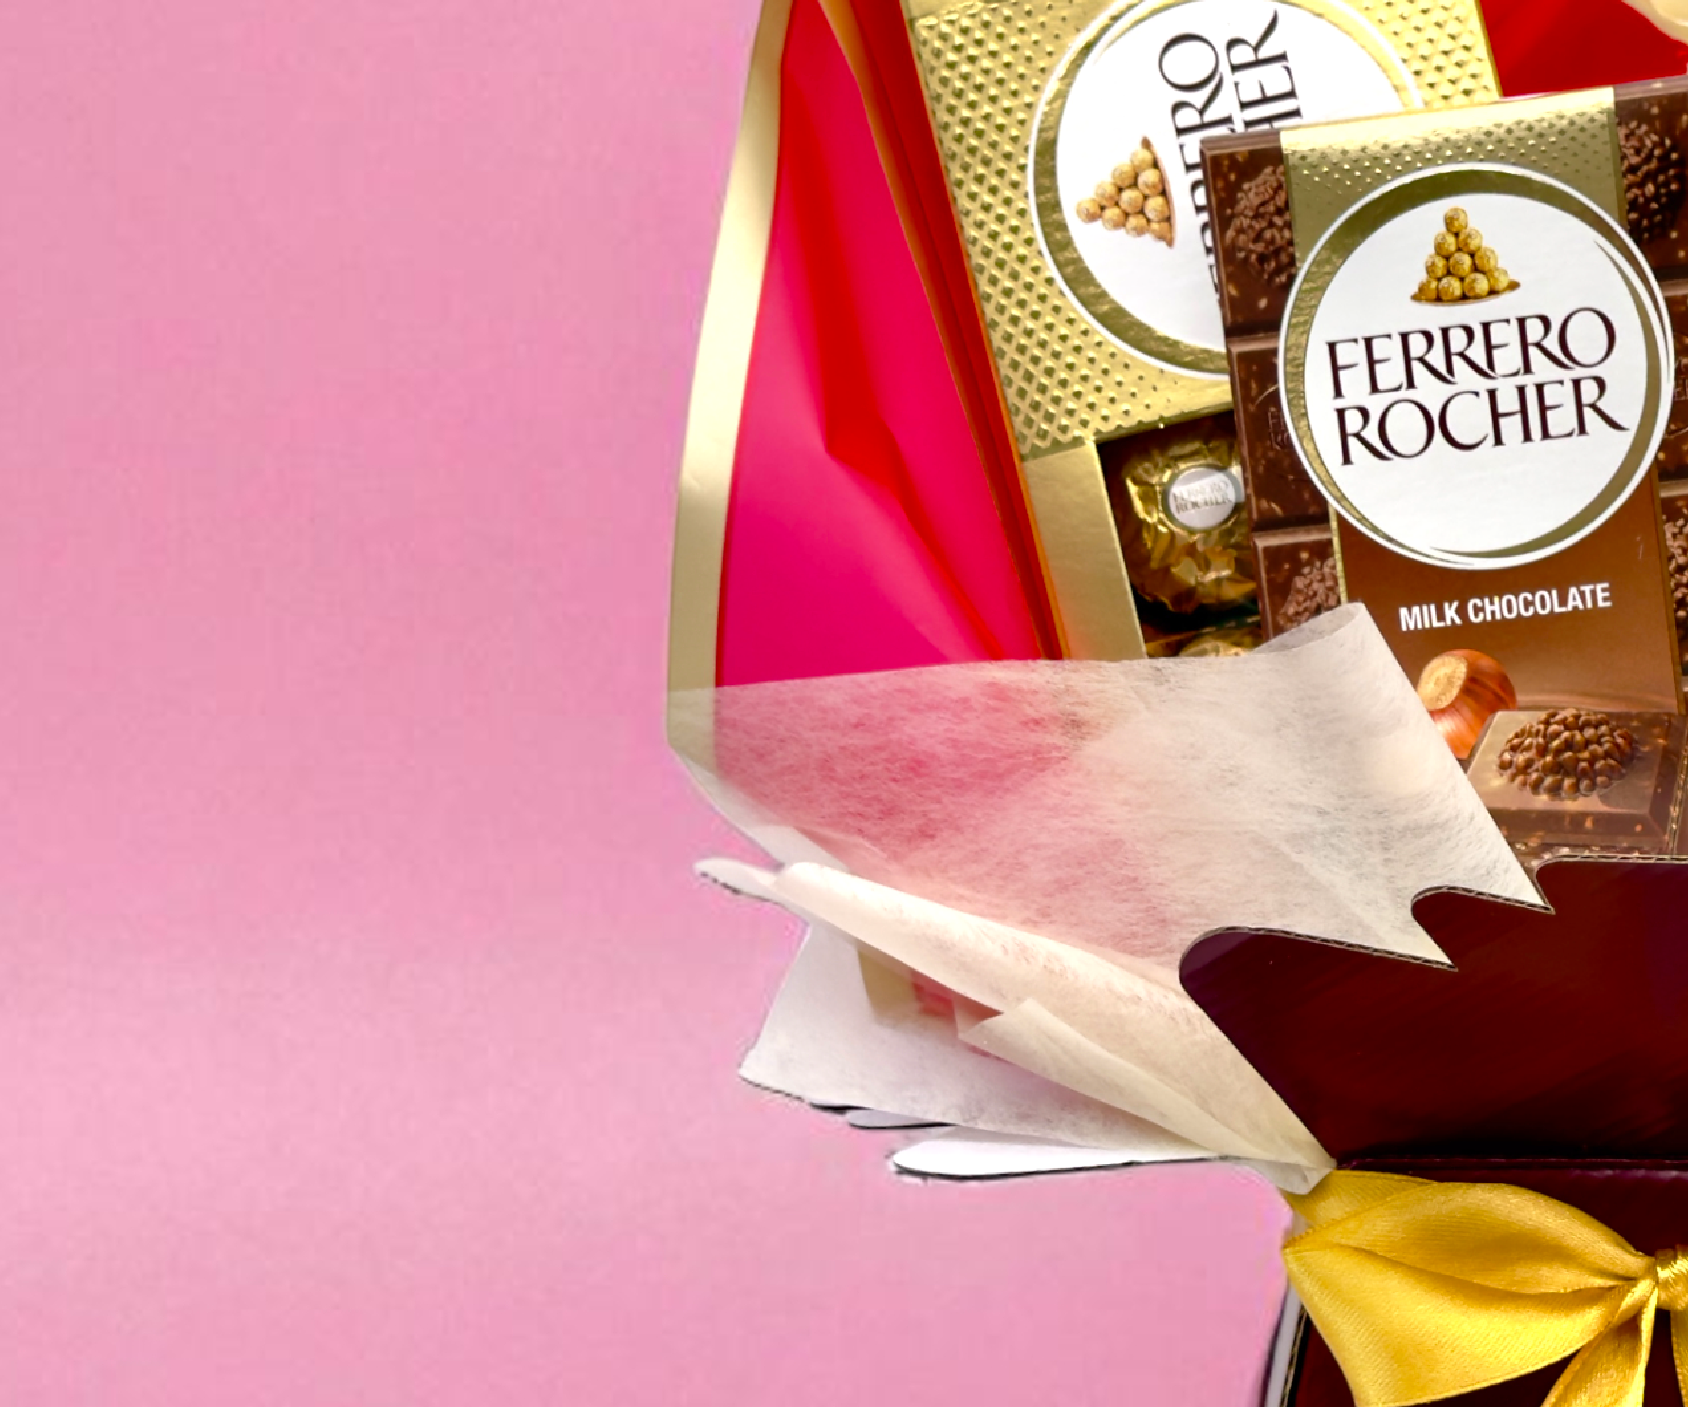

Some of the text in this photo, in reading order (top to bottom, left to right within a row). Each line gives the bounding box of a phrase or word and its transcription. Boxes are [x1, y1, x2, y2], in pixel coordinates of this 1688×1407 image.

[1326, 307, 1617, 400] FERRERO
[1334, 376, 1629, 466] ROCHER
[1399, 582, 1613, 631] MILK CHOCOLATE
